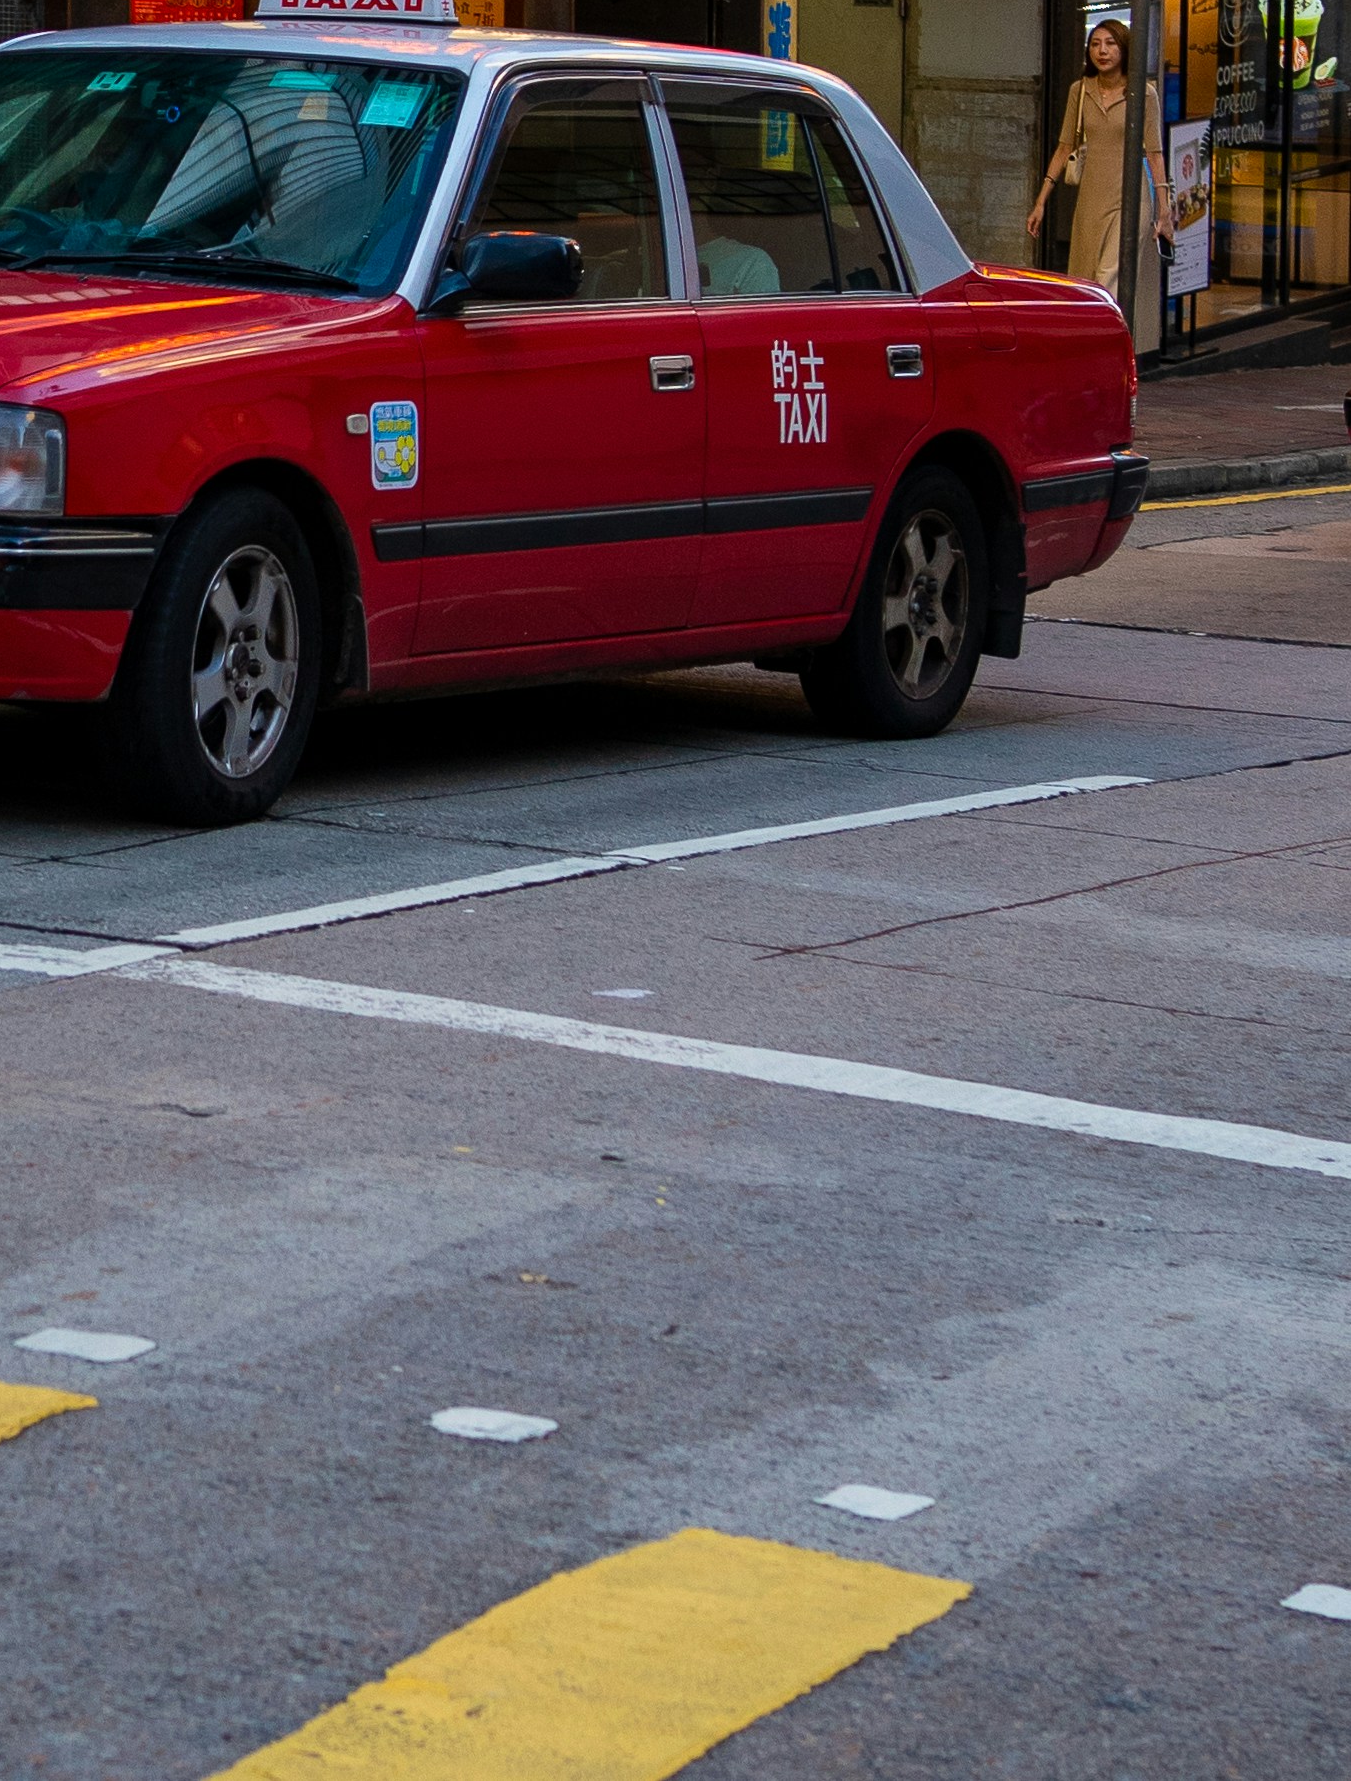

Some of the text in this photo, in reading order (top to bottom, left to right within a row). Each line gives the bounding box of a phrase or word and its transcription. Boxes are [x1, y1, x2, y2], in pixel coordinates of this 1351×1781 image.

[1216, 60, 1255, 87] COFFEE
[770, 339, 825, 390] 的士
[772, 393, 828, 445] TAXI
